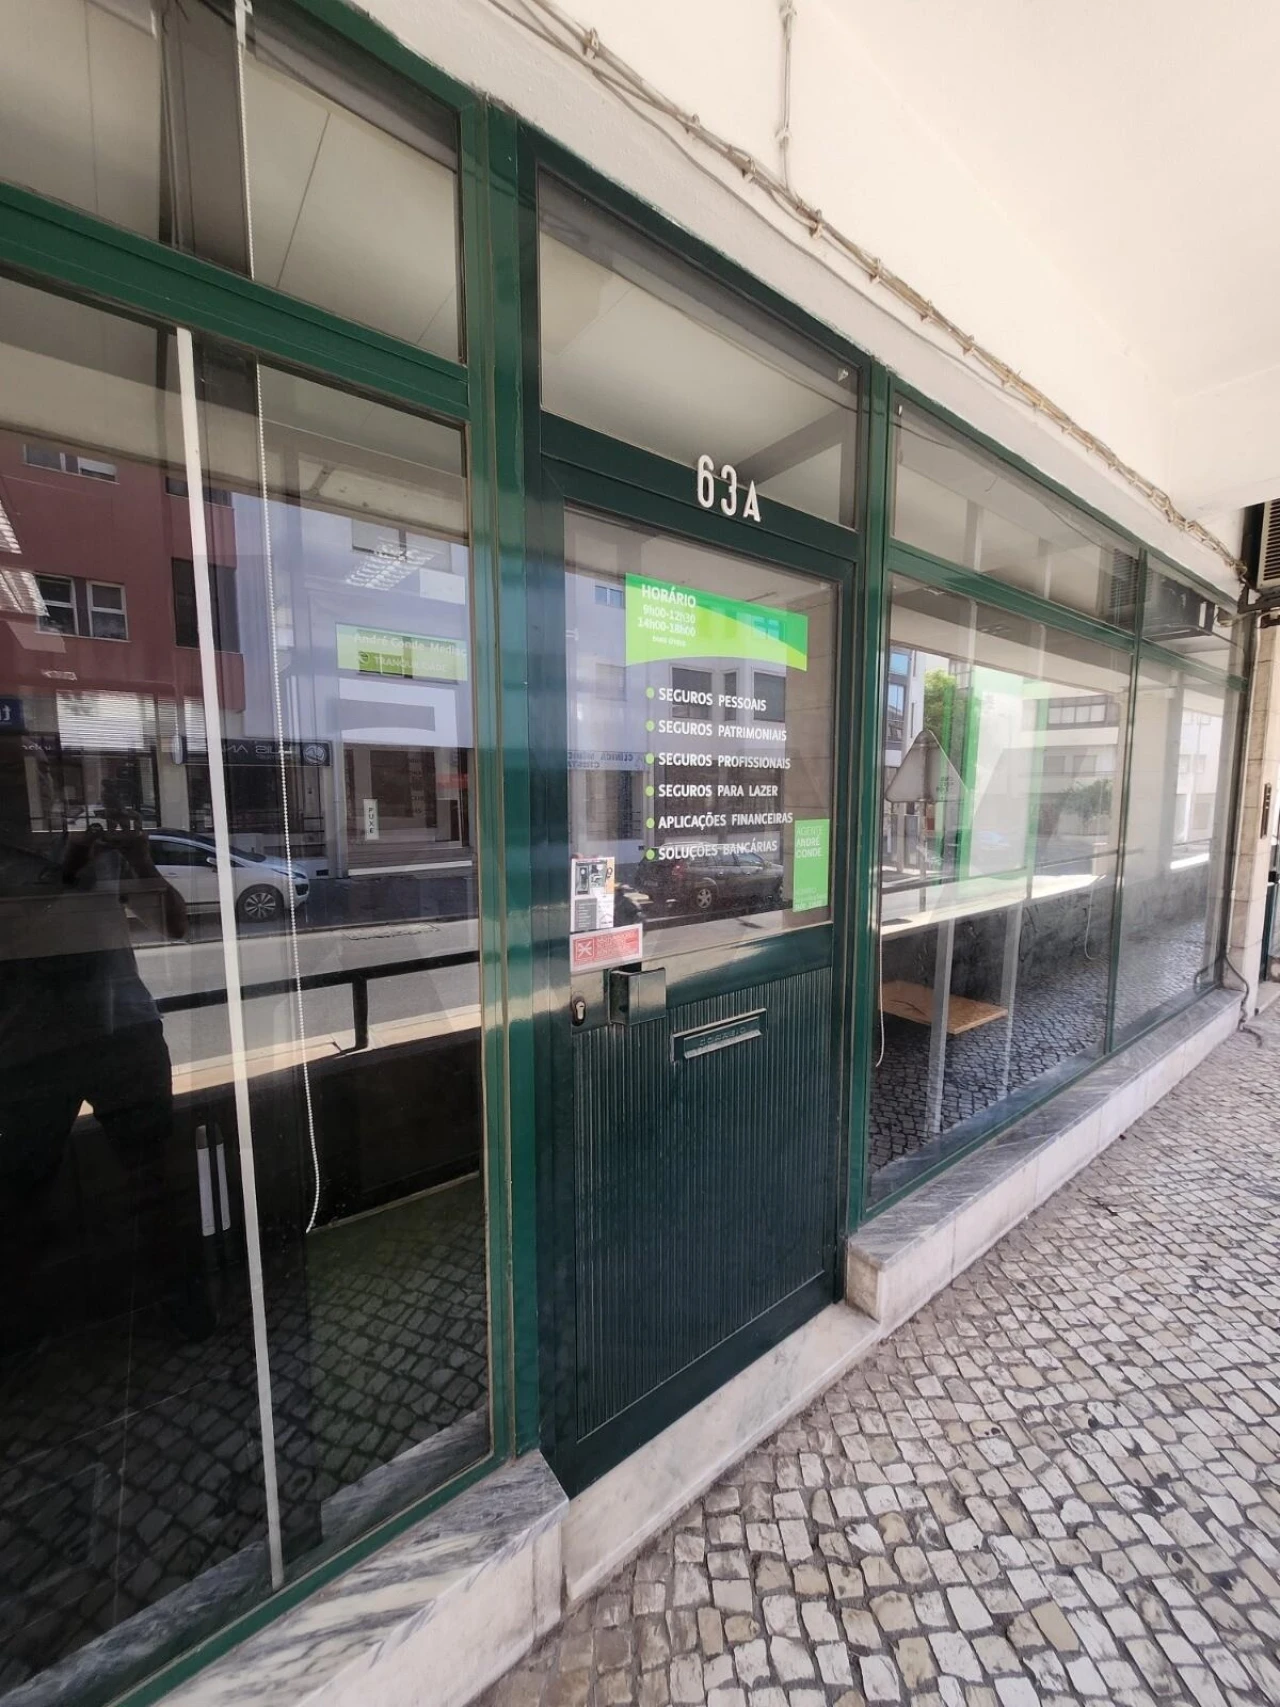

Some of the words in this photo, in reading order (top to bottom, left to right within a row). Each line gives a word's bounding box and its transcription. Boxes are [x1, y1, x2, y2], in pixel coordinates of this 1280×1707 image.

[641, 583, 697, 609] HORÁRIO
[658, 687, 713, 706] SEGUROS
[718, 694, 767, 712] PESSOAIS
[658, 719, 713, 737] SEGUROS
[718, 723, 787, 742] PATRIMONIAIS
[658, 751, 713, 768] SEGUROS
[717, 753, 791, 770] PROFISSIONAIS
[658, 783, 713, 798] SEGUROS
[717, 783, 745, 798] PARA
[749, 784, 779, 798] LAZER
[657, 812, 727, 831] APLICAÇÕES
[731, 811, 794, 826] FINANCEIRAS
[658, 843, 718, 862] SOLUÇÕES
[723, 837, 779, 856] BANCÁRIAS
[796, 834, 820, 848] ANDRÉ
[796, 847, 822, 859] CONDE
